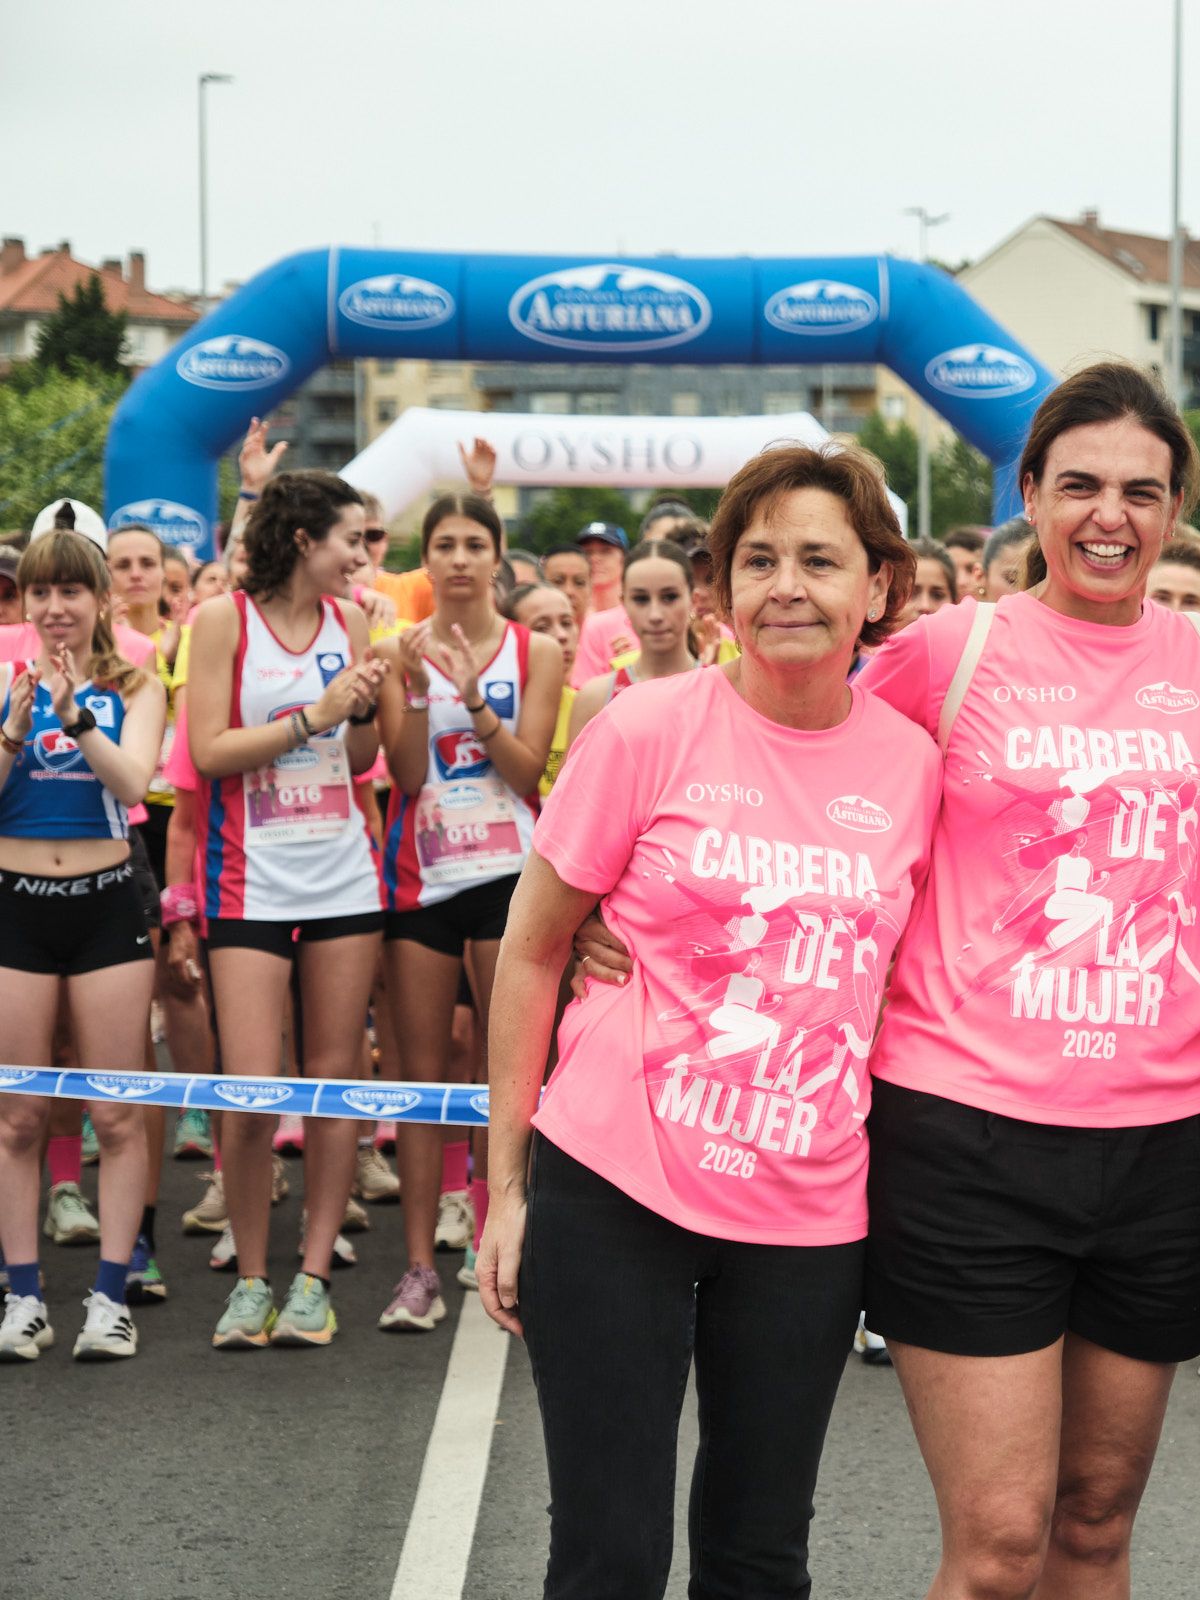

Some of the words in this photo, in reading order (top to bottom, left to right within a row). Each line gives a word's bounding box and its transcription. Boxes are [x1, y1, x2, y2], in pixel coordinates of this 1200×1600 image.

[525, 289, 697, 332] ASTURIANA
[512, 429, 704, 475] OYSHO
[993, 685, 1077, 703] OYSHO
[1142, 692, 1198, 708] ASTURIANA
[279, 783, 322, 807] 016
[686, 783, 764, 807] OYSHO
[832, 804, 888, 828] ASTURIANA
[1108, 786, 1178, 862] DE
[447, 822, 490, 845] 016
[14, 877, 91, 897] NIKE
[781, 911, 855, 990] DE
[1010, 966, 1165, 1027] MUJER
[1062, 1029, 1117, 1060] 2026
[656, 1069, 819, 1158] MUJER
[698, 1140, 758, 1180] 2026
